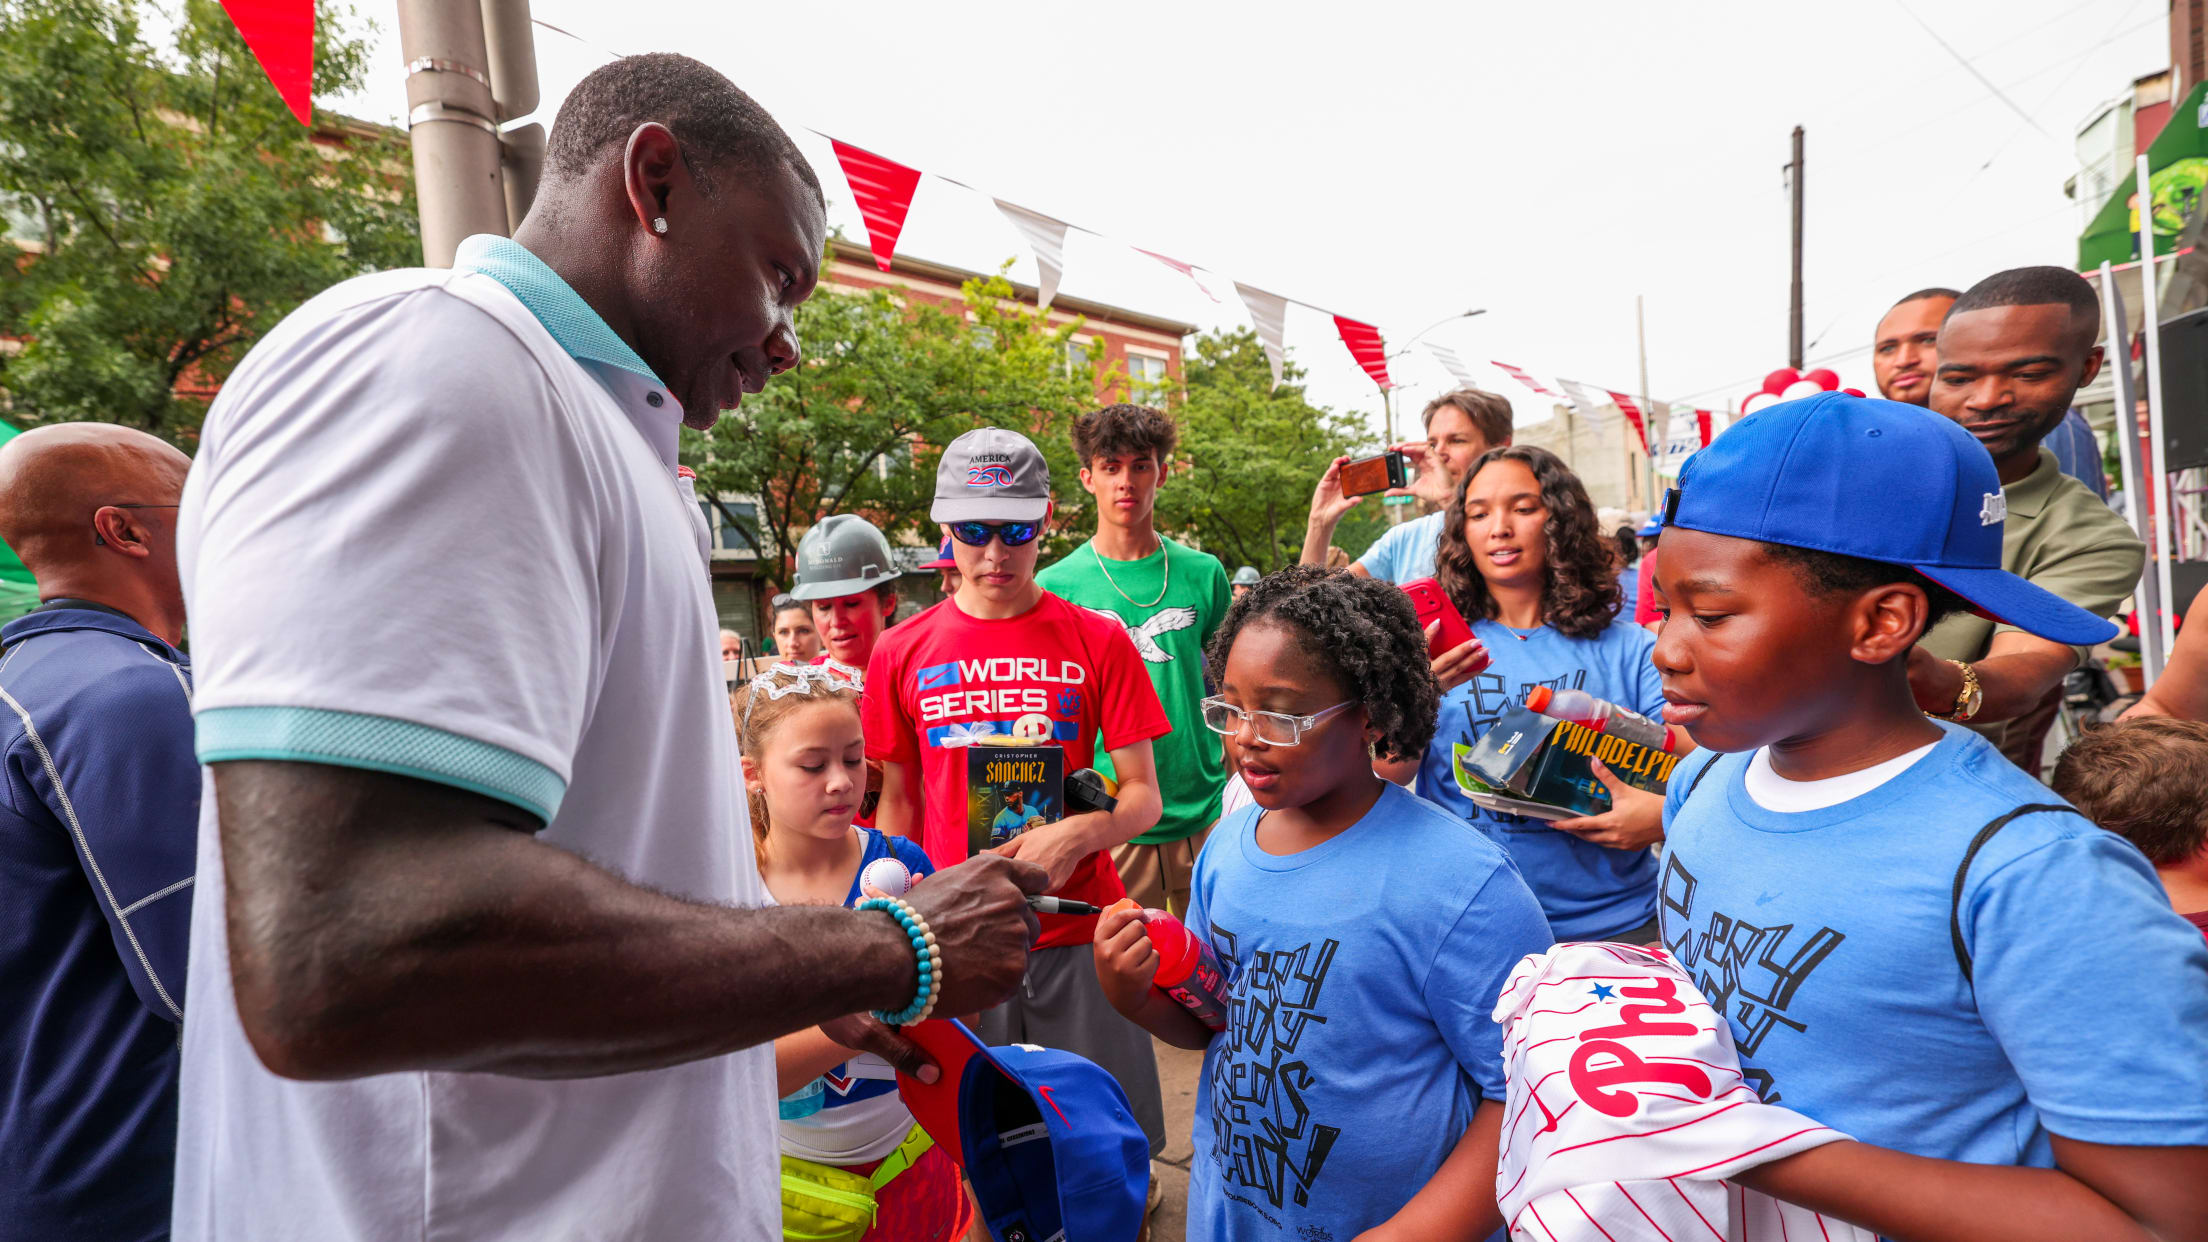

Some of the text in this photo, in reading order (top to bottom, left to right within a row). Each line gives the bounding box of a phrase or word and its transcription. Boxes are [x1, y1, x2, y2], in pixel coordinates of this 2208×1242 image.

[969, 454, 1011, 464] AMERICA
[967, 464, 1014, 488] 250
[959, 658, 1086, 685] WORLD
[920, 689, 1048, 721] SERIES
